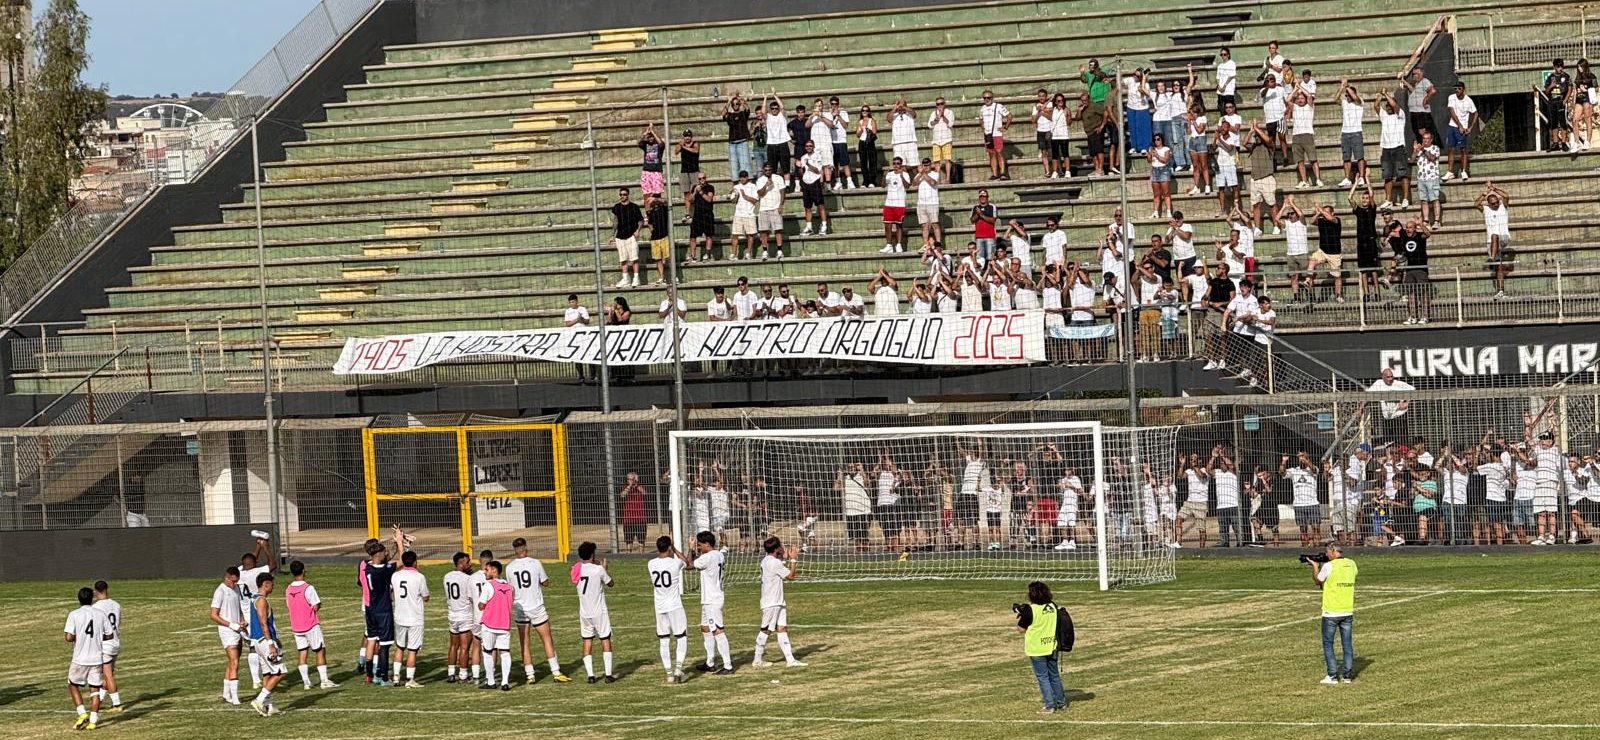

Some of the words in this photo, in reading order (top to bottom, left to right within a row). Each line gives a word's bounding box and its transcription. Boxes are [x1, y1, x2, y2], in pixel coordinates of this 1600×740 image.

[414, 336, 456, 367] LA
[450, 332, 561, 356] NOSTRA
[697, 321, 819, 359] NOSTRO
[818, 317, 943, 360] ORGOGLIO
[954, 313, 1026, 360] 2025
[1379, 346, 1500, 378] CURVA
[366, 573, 374, 591] 1
[514, 569, 532, 589] 19
[580, 576, 589, 595] 7
[651, 570, 672, 588] 20
[399, 580, 408, 599] 5
[446, 581, 461, 600] 10
[85, 619, 94, 638] 4
[107, 612, 117, 631] 9
